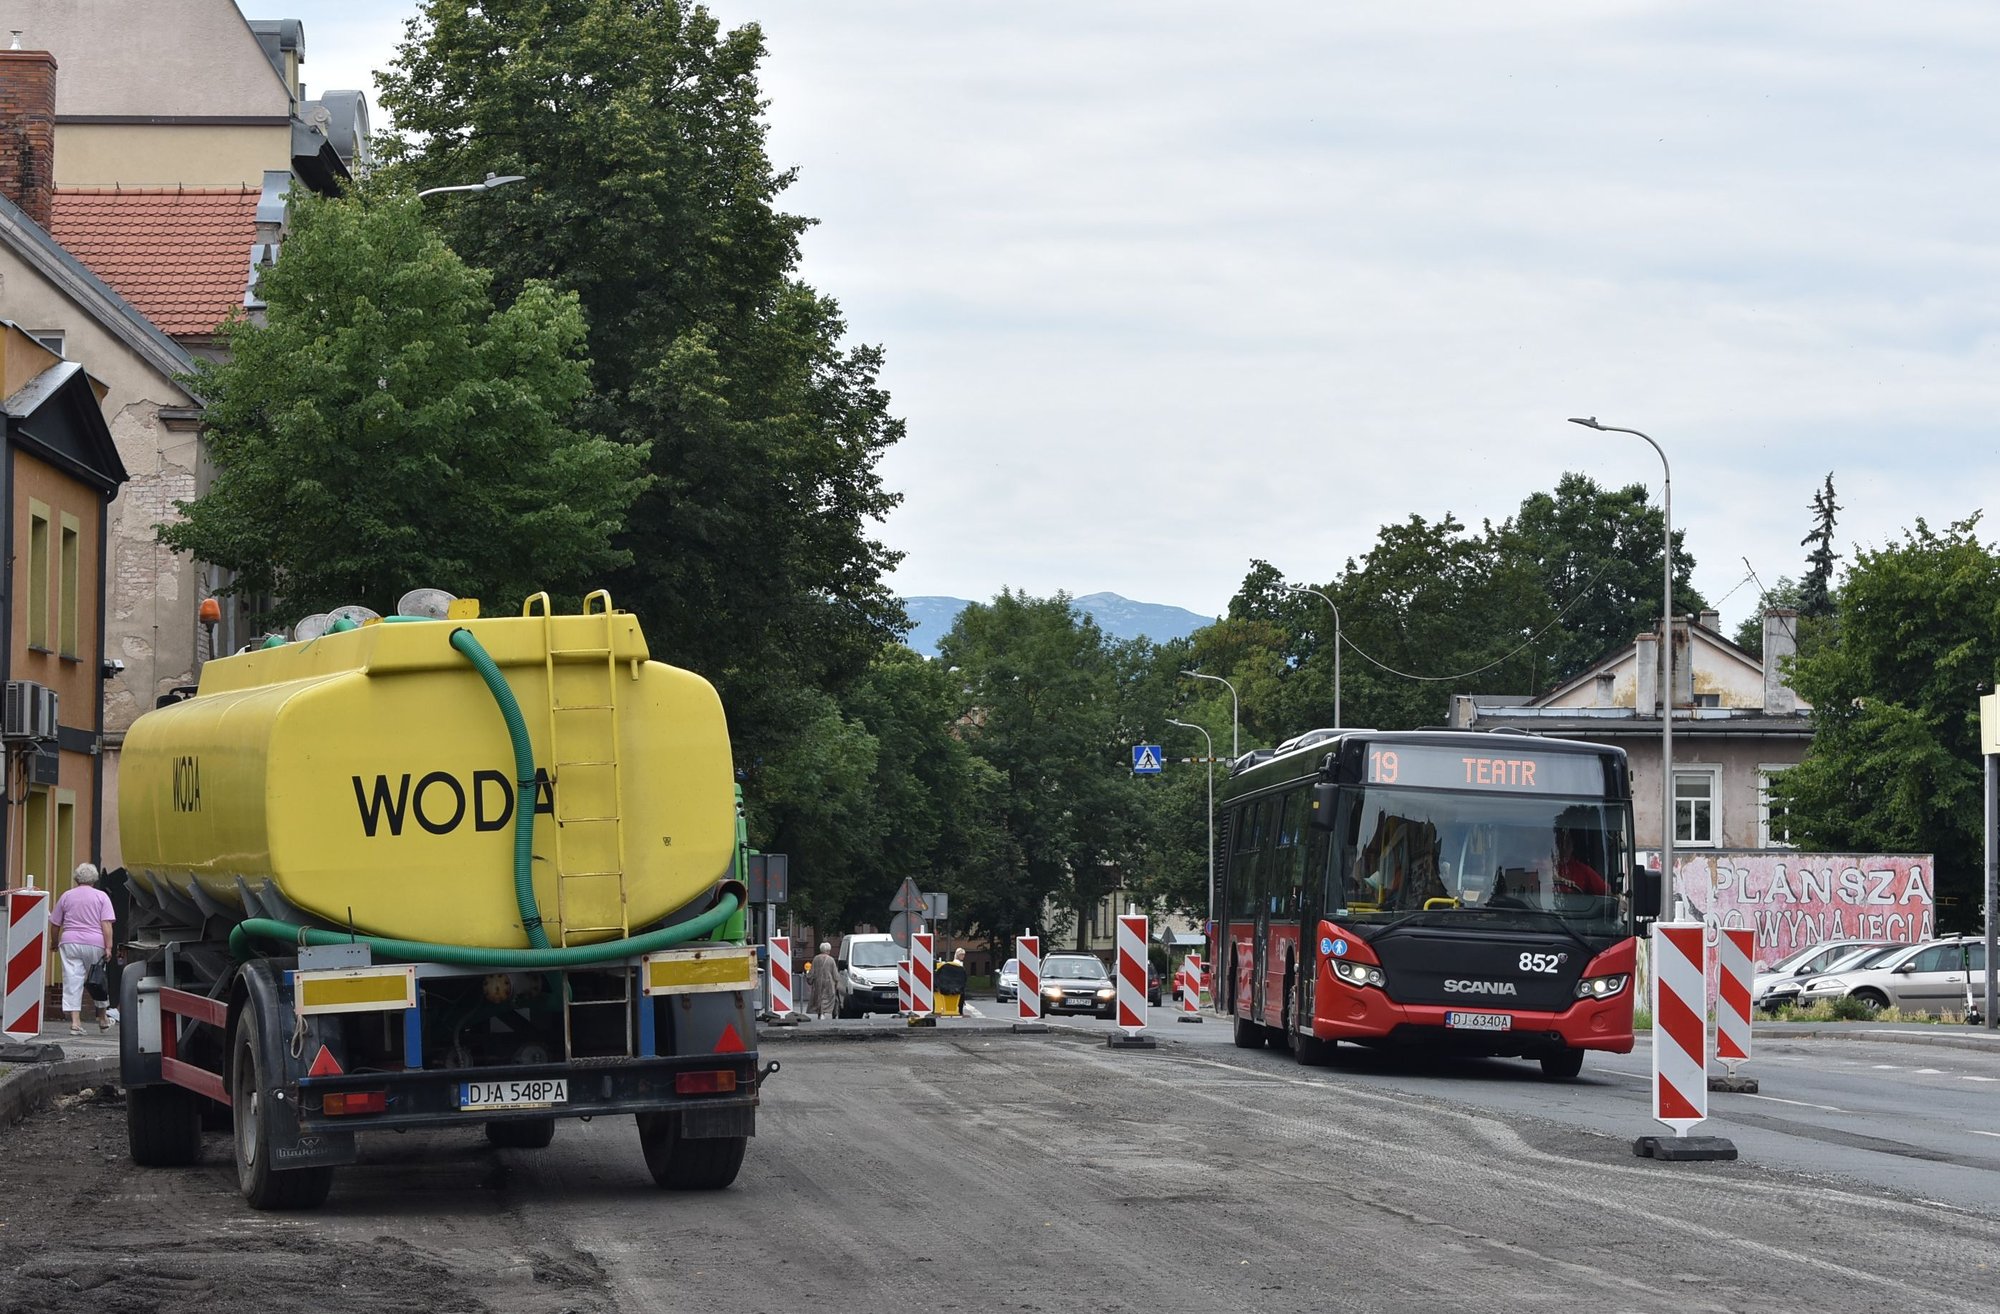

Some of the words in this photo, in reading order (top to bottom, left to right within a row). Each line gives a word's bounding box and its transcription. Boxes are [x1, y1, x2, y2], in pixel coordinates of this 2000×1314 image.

[1371, 751, 1398, 783] 19
[1462, 758, 1536, 786] TEATR
[173, 755, 201, 812] WODA
[352, 767, 564, 837] WODA
[1705, 863, 1933, 906] PLANSZA
[1518, 952, 1559, 974] 852
[1443, 979, 1517, 995] SCANIA
[1453, 1013, 1468, 1026] DJ
[1472, 1015, 1508, 1028] 6340A
[511, 1082, 565, 1102] 548PA
